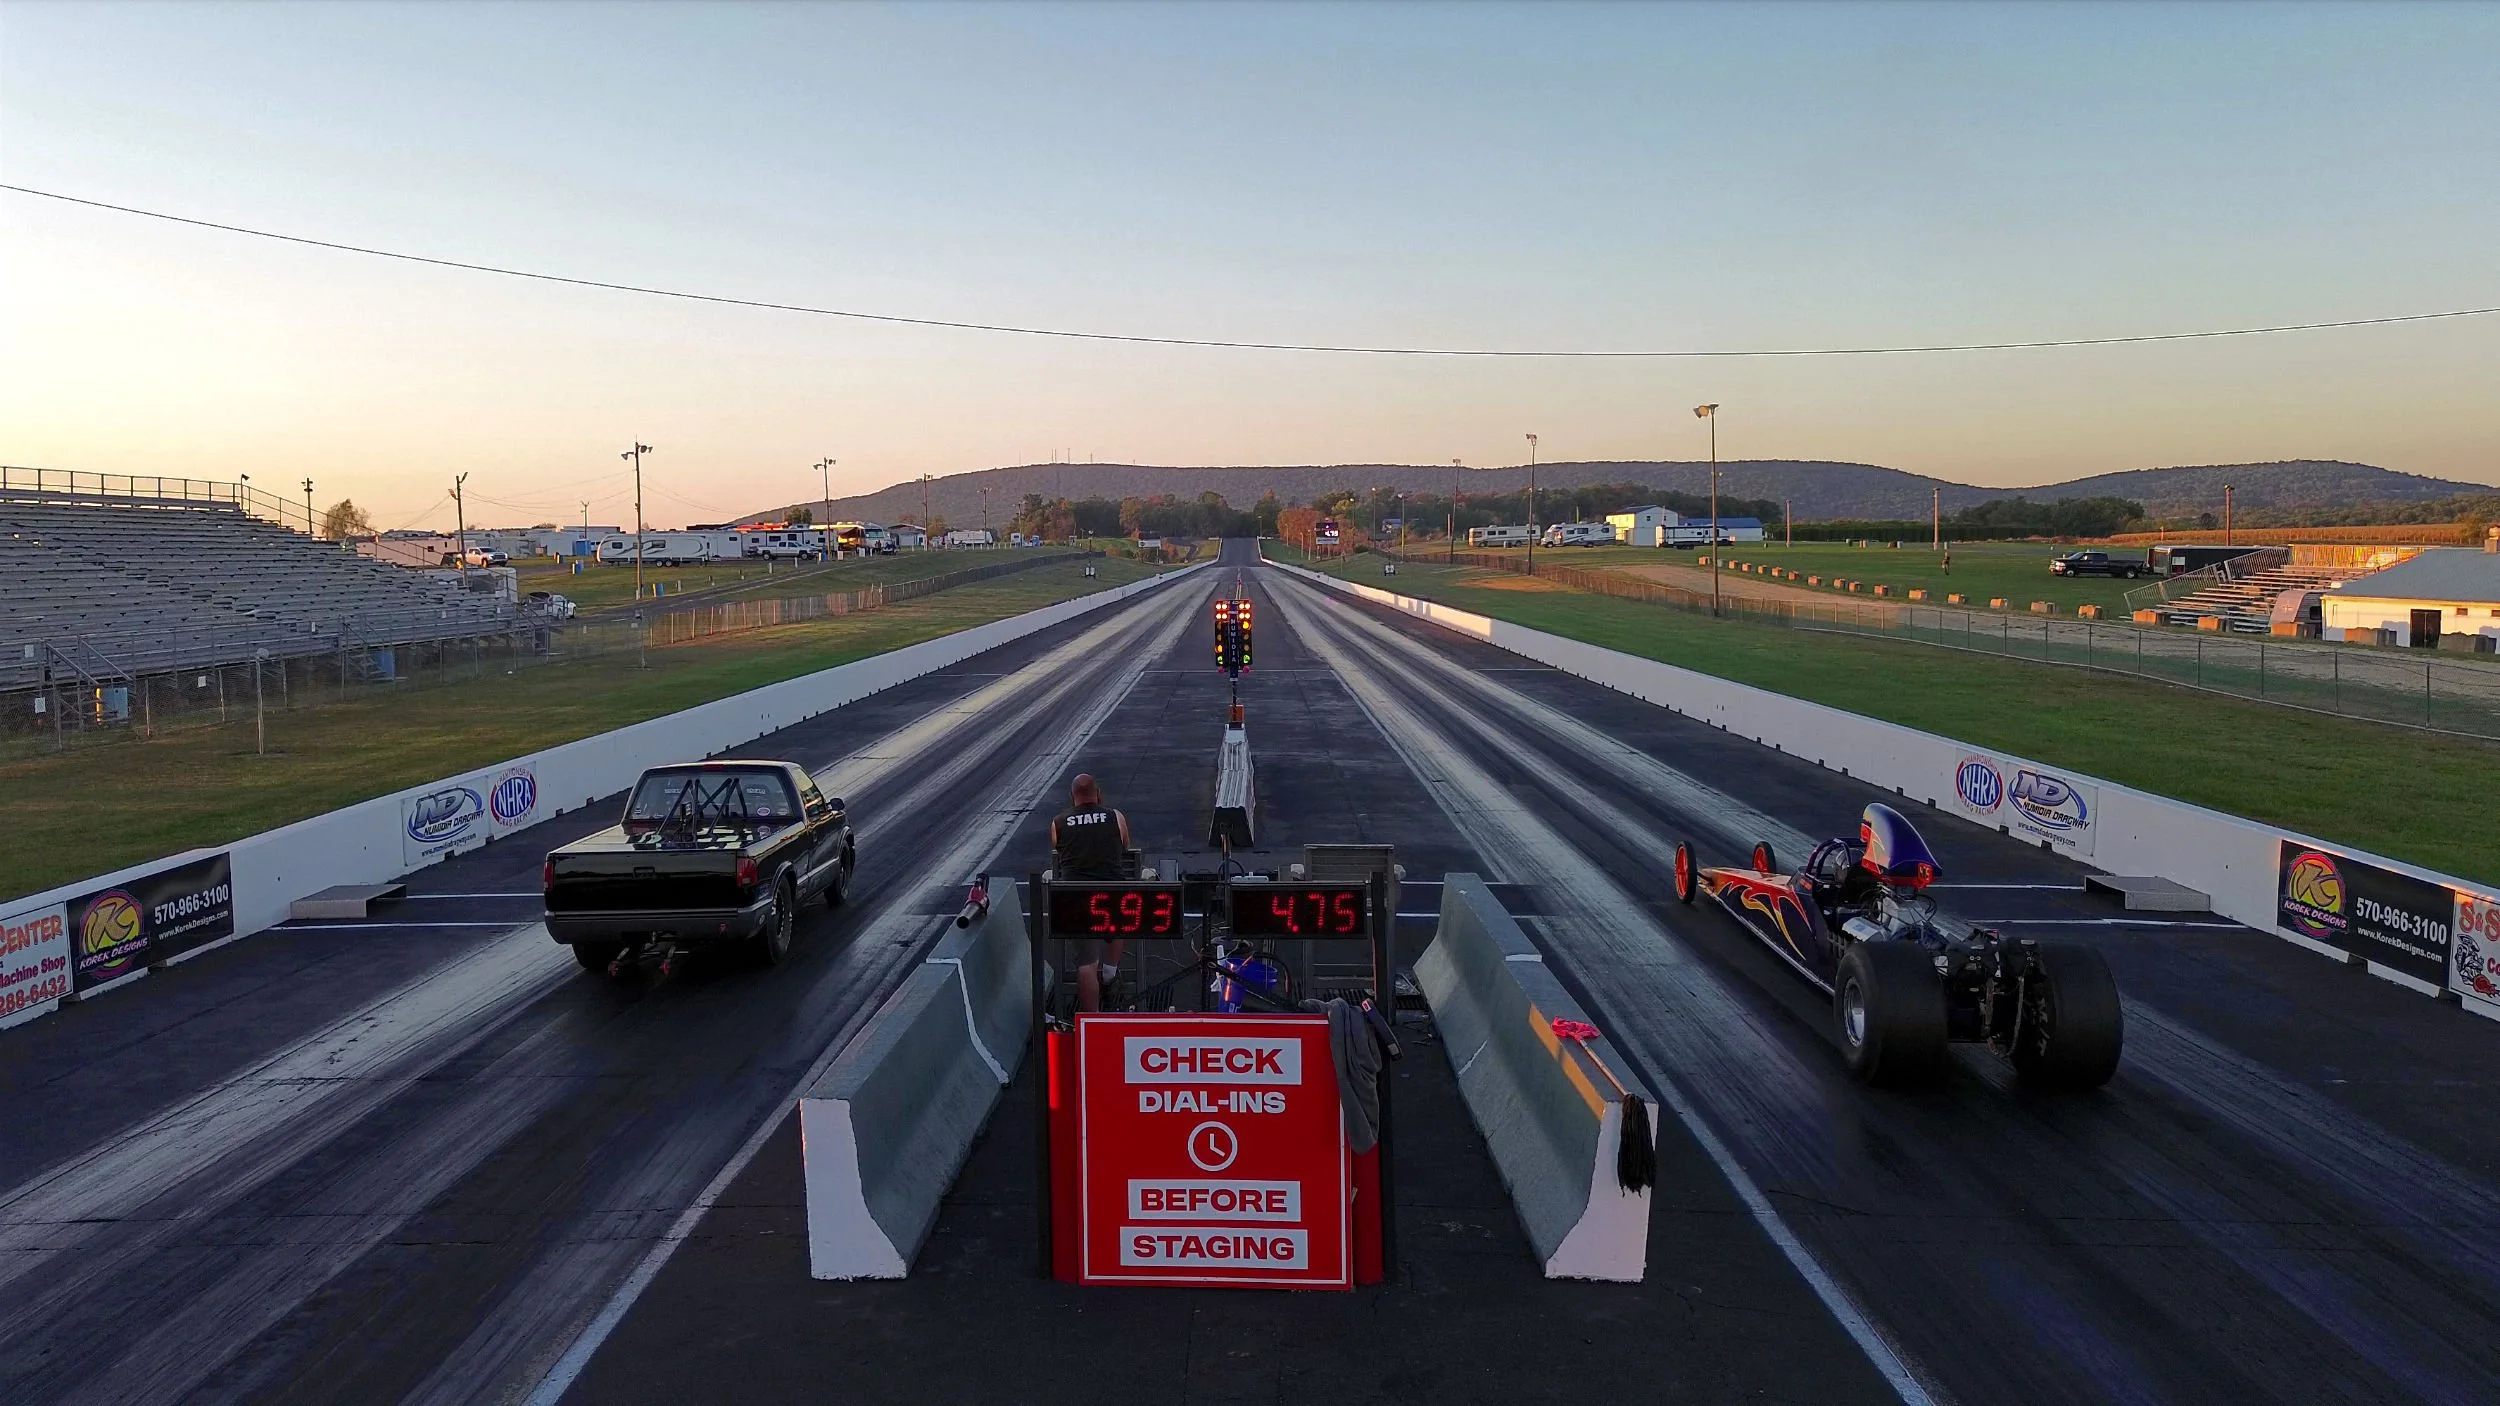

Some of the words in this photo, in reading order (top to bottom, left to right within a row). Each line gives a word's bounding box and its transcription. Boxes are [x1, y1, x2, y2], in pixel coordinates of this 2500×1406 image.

[498, 778, 531, 817] NHRA
[1962, 765, 1996, 804] NHRA
[1066, 813, 1107, 826] STAFF
[1975, 806, 1994, 817] RACING
[2022, 802, 2051, 819] NUMIDIA
[2052, 811, 2090, 831] DRAGWAY
[154, 884, 229, 925] 570-966-3100
[1090, 892, 1174, 932] 5.93
[1271, 892, 1355, 932] 4.75
[2284, 901, 2311, 917] KOREK
[2311, 910, 2347, 929] DESIGNS
[158, 909, 229, 941] www.KorekDesigns.com
[2356, 897, 2447, 945] 570-966-3100
[79, 951, 109, 970] KOREK
[110, 937, 148, 958] DESIGNS
[2357, 927, 2443, 963] www.KorekDesigns.com
[41, 955, 66, 974] Shop
[1139, 1047, 1284, 1075] CHECK
[1138, 1090, 1286, 1114] DIAL-INS
[1140, 1188, 1288, 1213] BEFORE
[1133, 1235, 1295, 1260] STAGING
